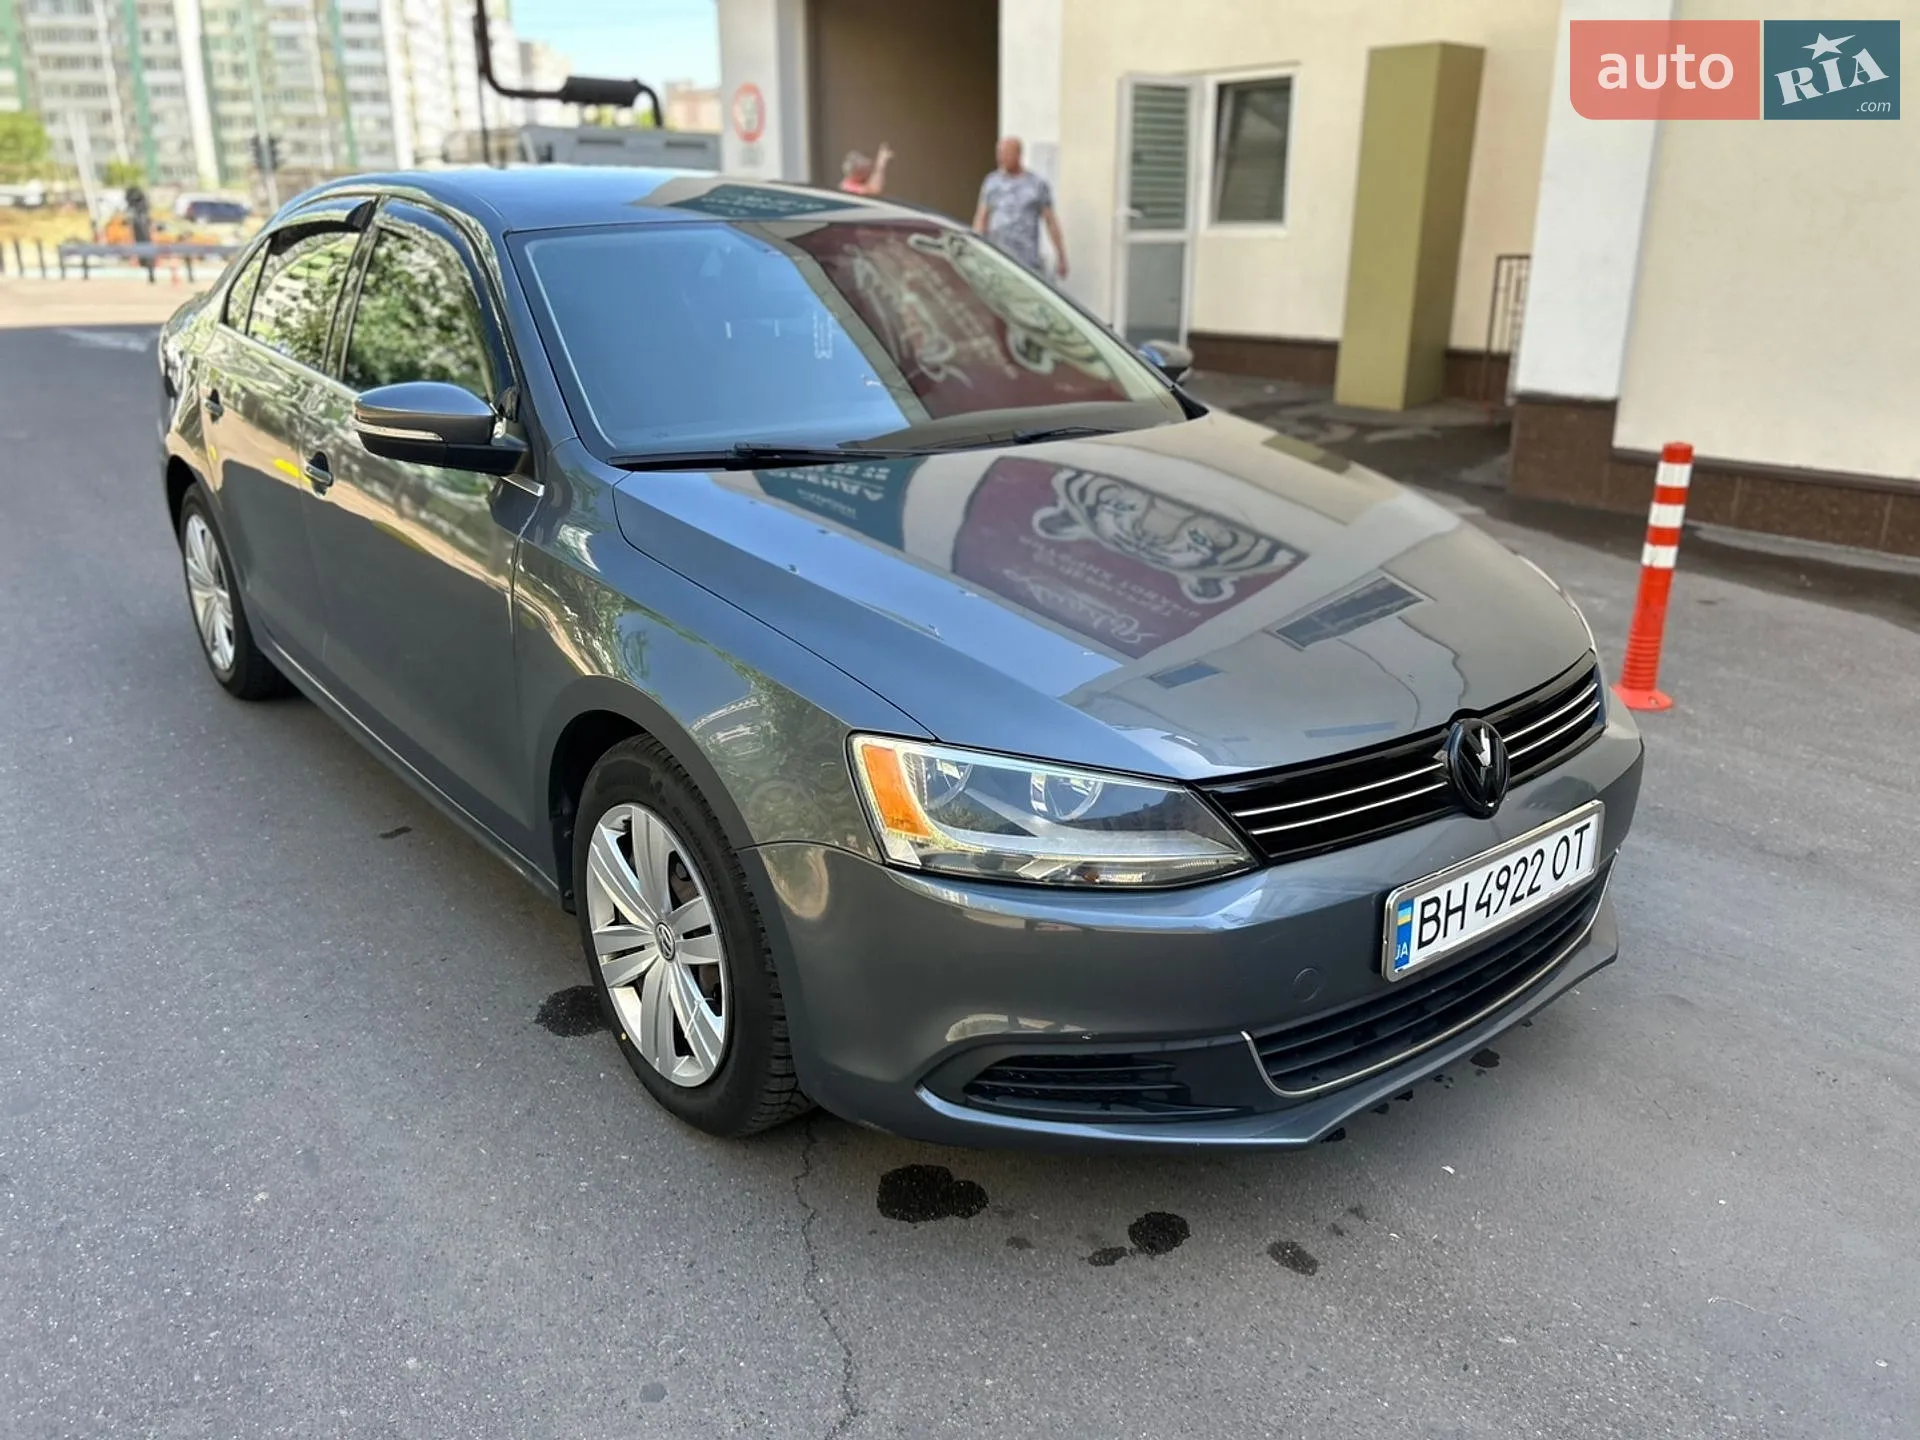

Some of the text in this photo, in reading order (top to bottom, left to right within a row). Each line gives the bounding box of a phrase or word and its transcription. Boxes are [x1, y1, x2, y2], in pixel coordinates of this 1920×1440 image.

[1417, 822, 1592, 950] BH 4922 OT
